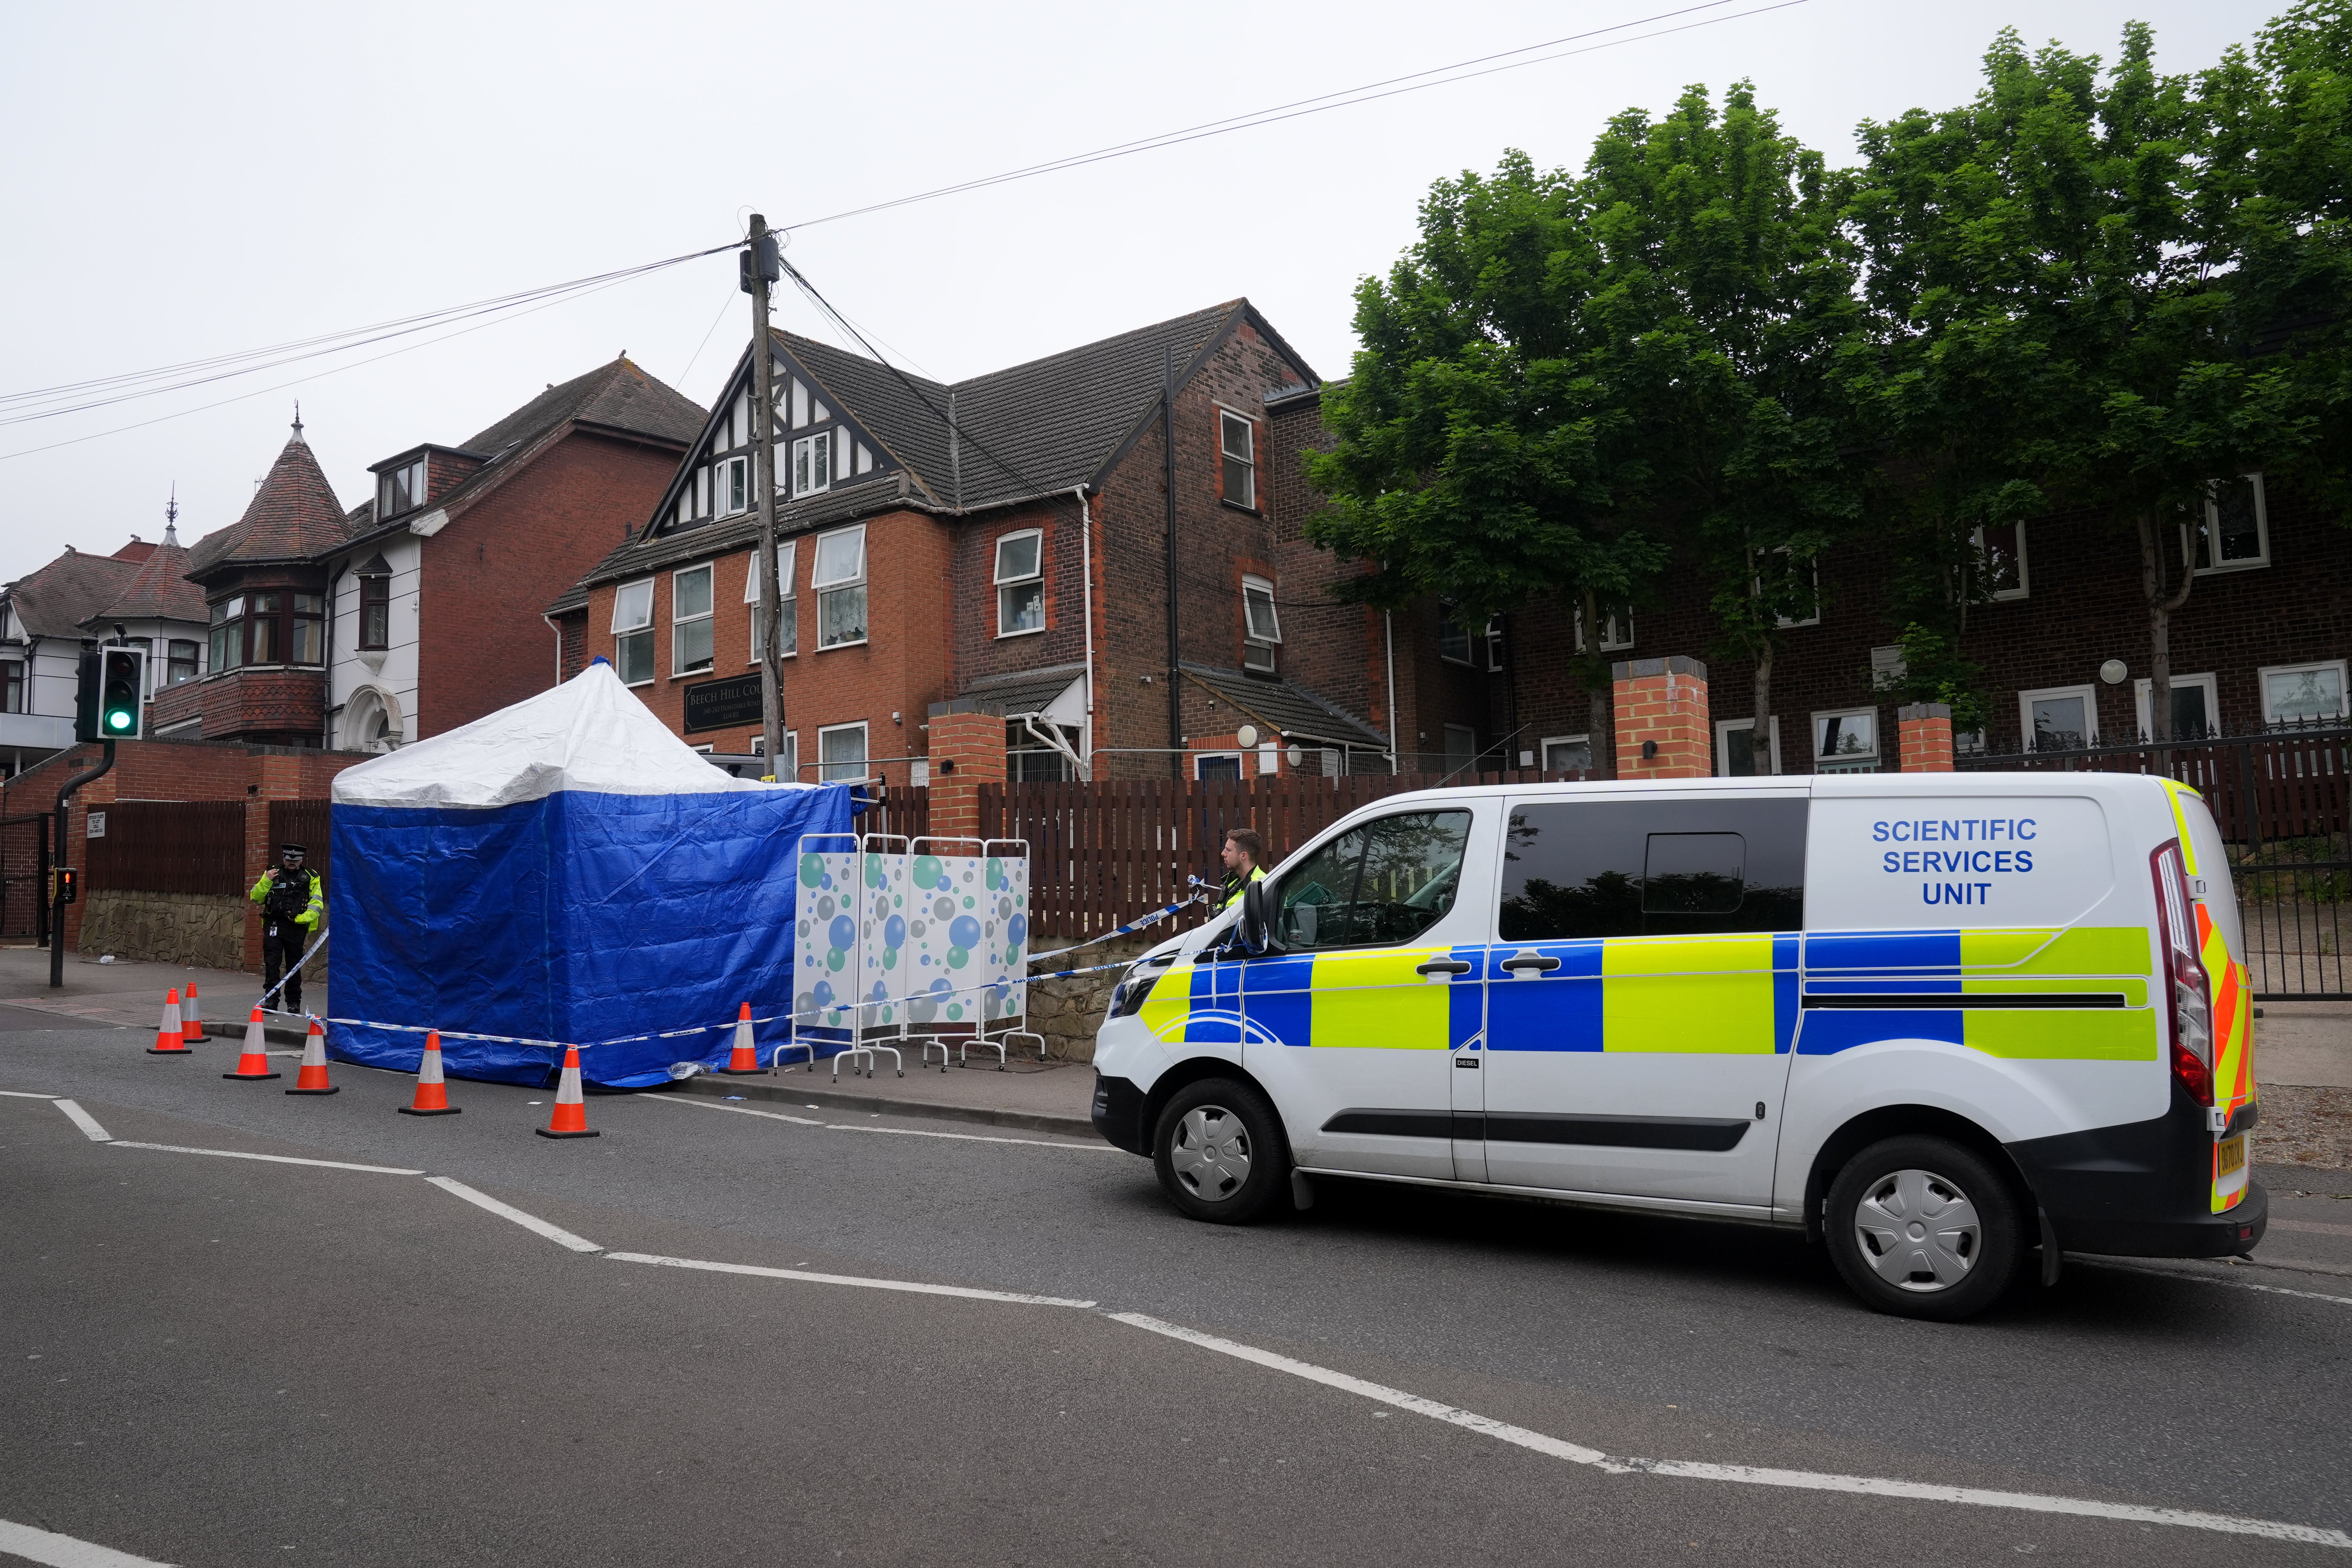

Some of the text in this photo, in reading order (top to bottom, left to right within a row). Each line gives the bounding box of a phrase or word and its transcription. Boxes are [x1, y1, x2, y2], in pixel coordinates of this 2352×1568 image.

[691, 692, 717, 706] BEECH
[720, 688, 740, 700] HILL
[703, 706, 720, 714] 240-242
[721, 702, 746, 711] DUNSTABLE
[1872, 818, 2037, 842] SCIENTIFIC
[1883, 850, 2033, 873] SERVICES
[1923, 883, 1992, 905] UNIT
[1139, 913, 1159, 926] POLICE
